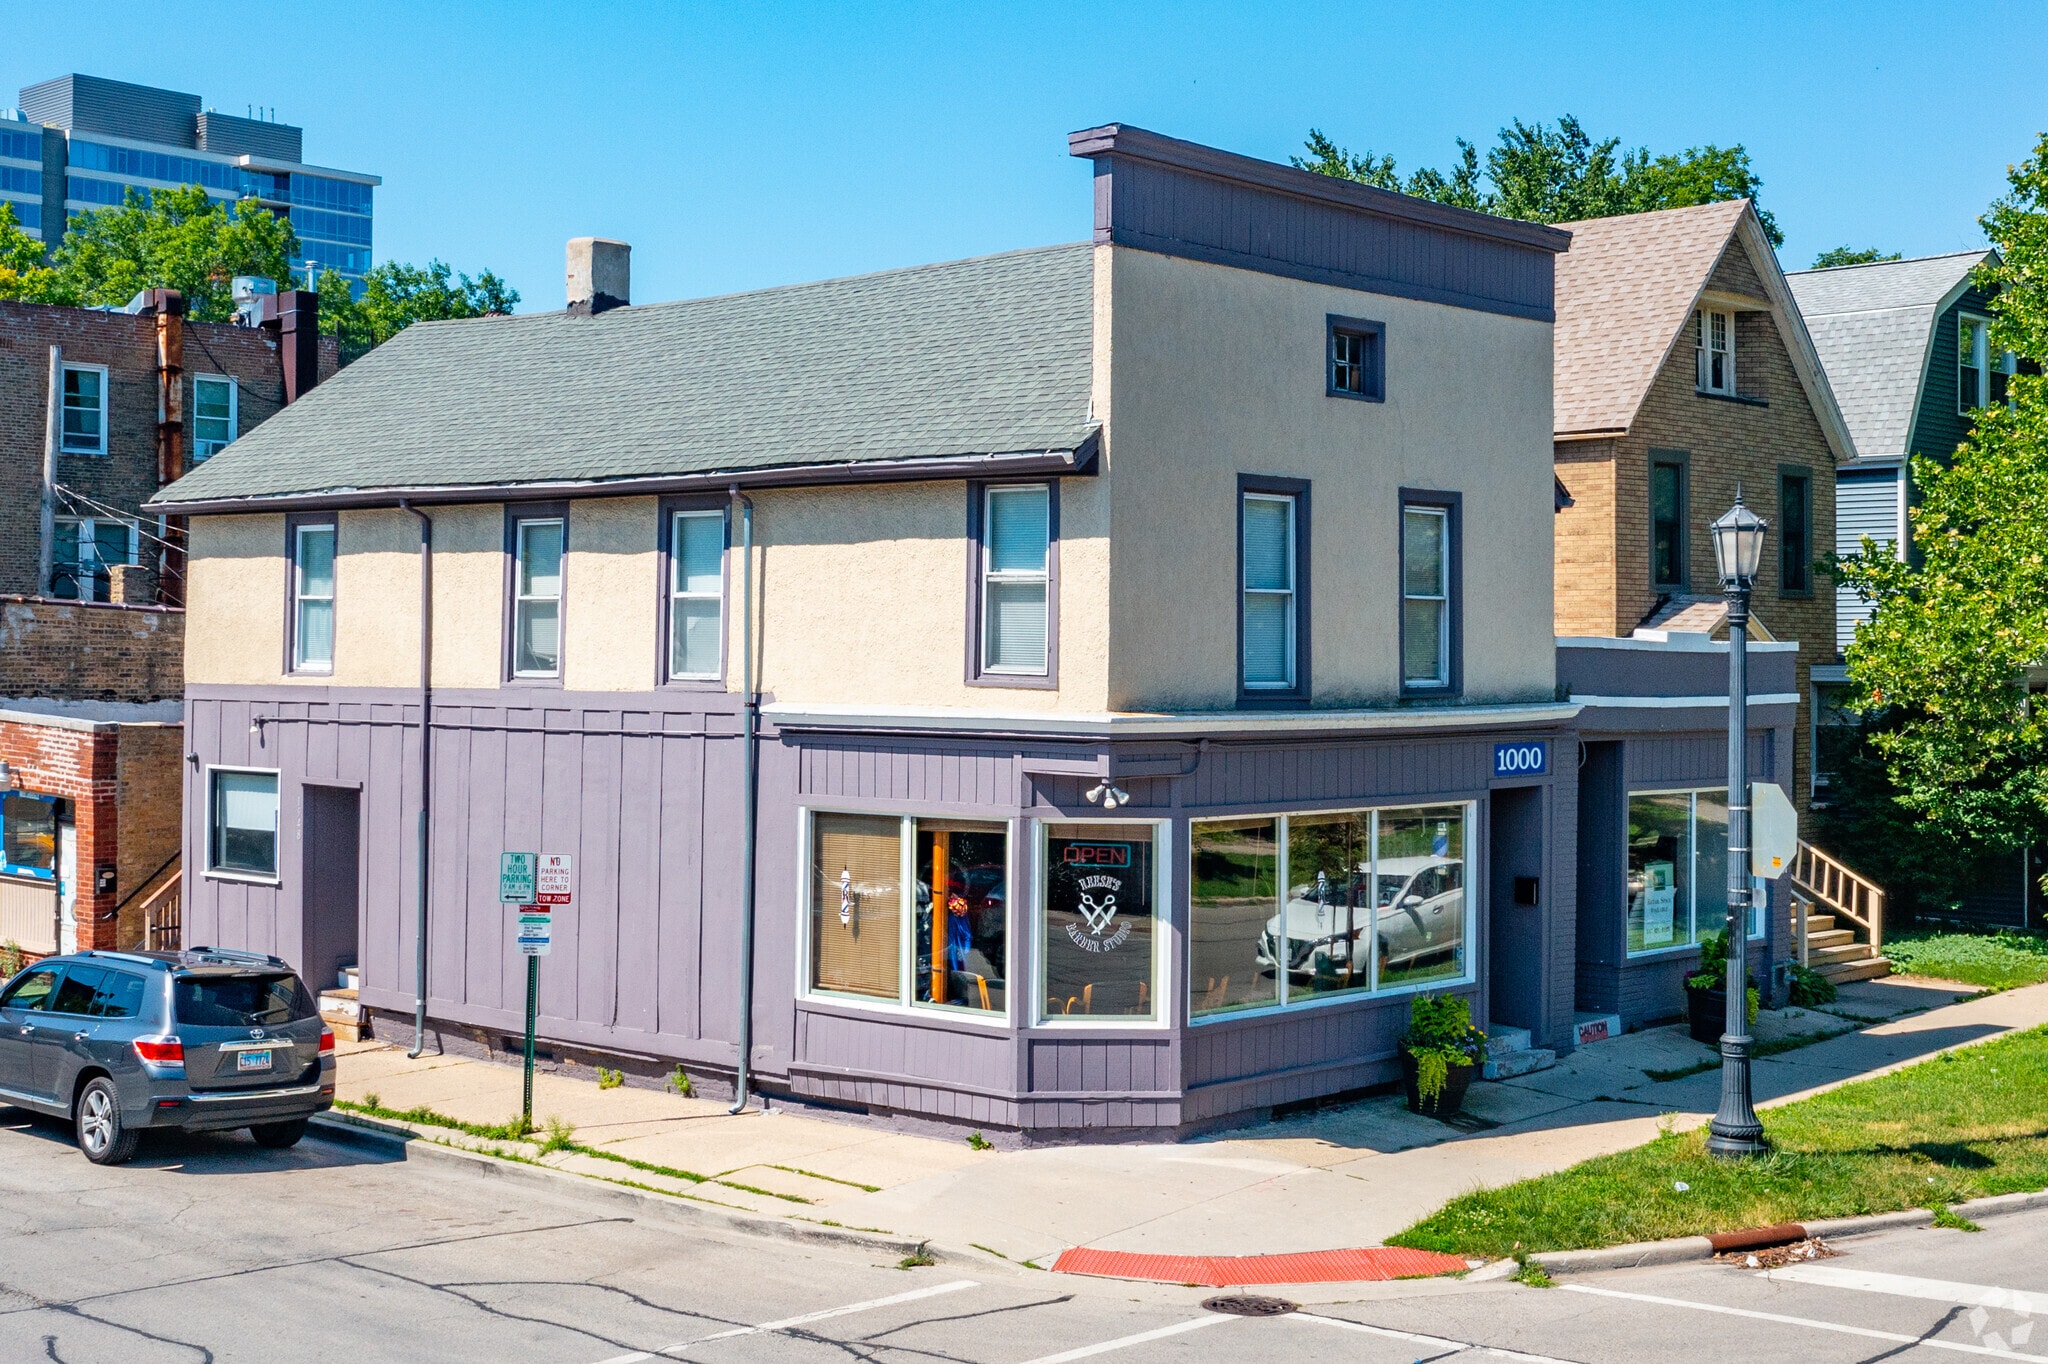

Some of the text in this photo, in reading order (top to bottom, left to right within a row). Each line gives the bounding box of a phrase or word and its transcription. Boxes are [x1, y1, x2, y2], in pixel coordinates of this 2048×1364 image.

[1497, 747, 1542, 770] 1000
[510, 854, 525, 864] TWO
[550, 857, 561, 866] NO
[1063, 846, 1125, 864] OPEN
[507, 864, 528, 874] HOUR
[502, 874, 532, 884] PARKING
[1078, 875, 1122, 891] REESE'S
[553, 895, 569, 903] ZONE
[1066, 921, 1132, 952] BARBER STUDIO
[1579, 1020, 1608, 1036] CAUTION
